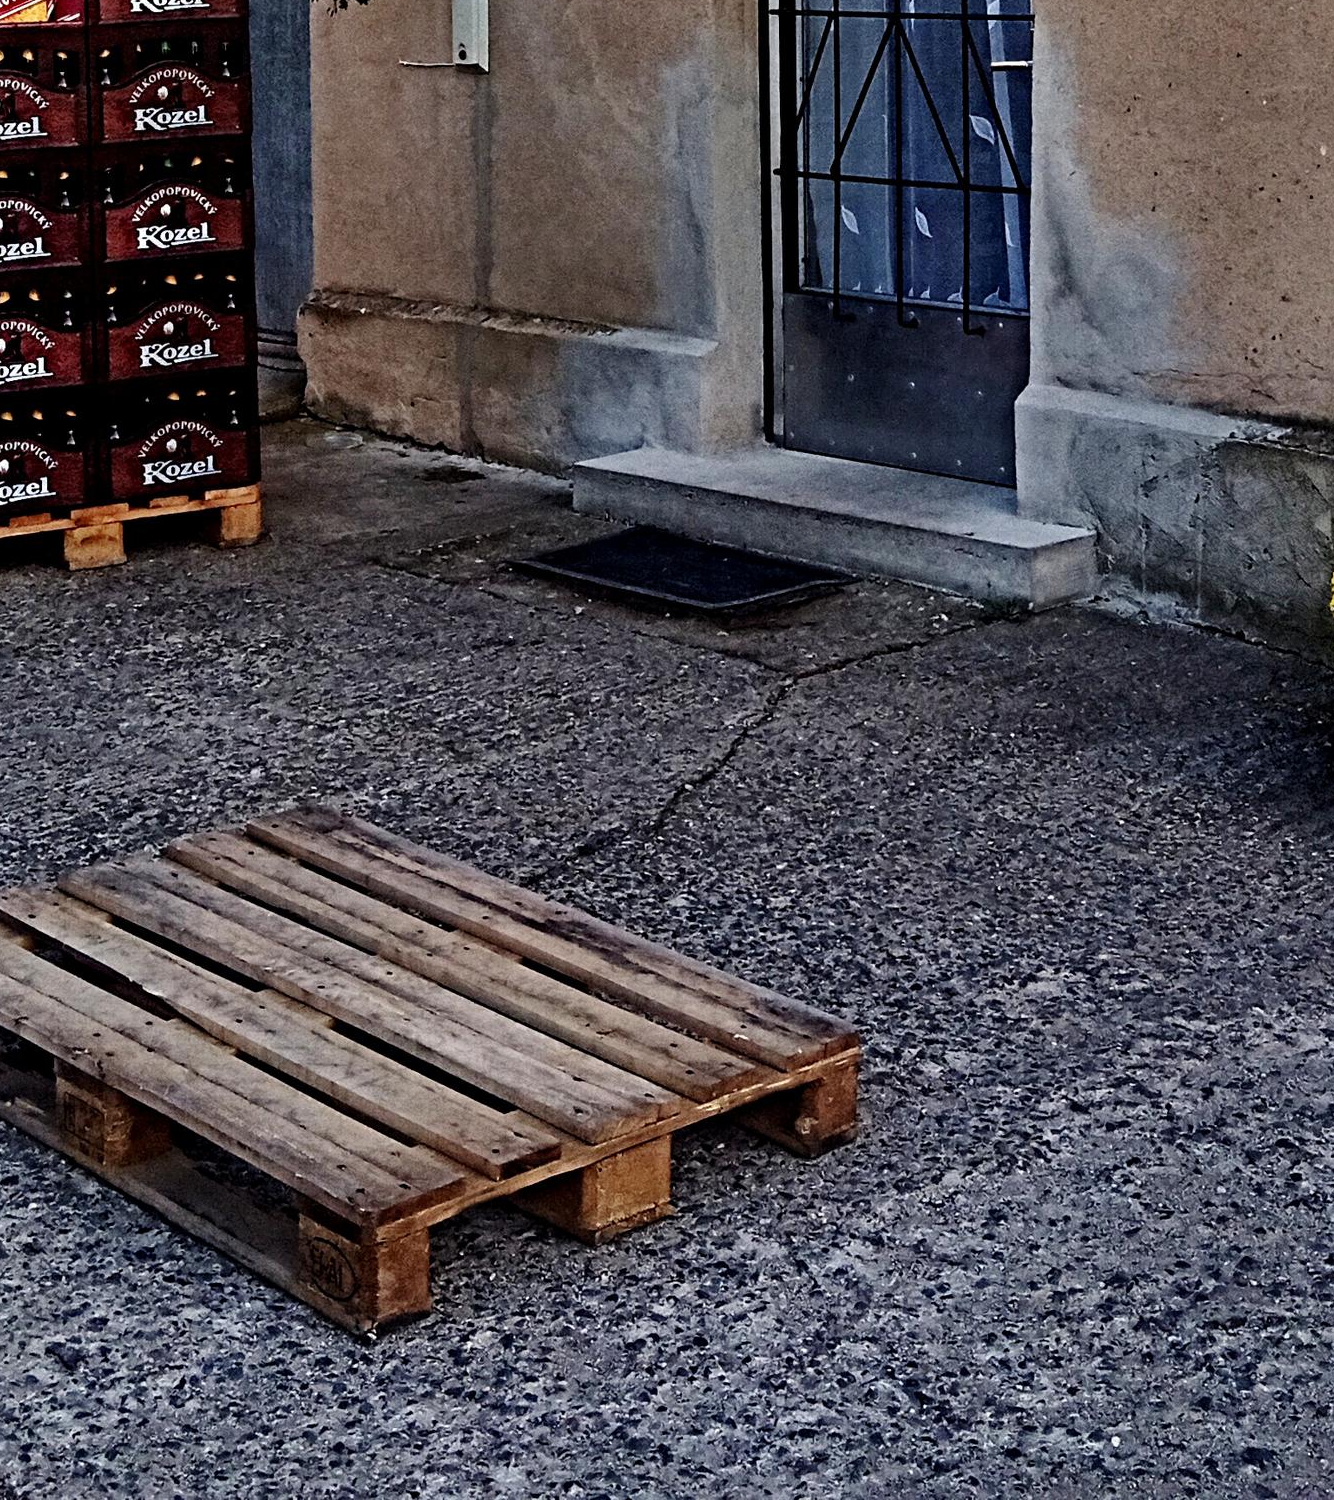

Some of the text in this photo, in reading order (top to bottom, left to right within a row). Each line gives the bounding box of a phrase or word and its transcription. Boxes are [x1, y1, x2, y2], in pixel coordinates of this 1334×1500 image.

[128, 68, 215, 104] VELKOPOPOVICKÝ
[134, 105, 213, 131] Kozel
[131, 186, 218, 223] VELKOPOPOVICKÝ
[136, 222, 216, 250] Kozel
[139, 338, 219, 368] Kozel
[137, 420, 224, 459] VELKOPOPOVICKÝ
[142, 455, 222, 485] Kozel
